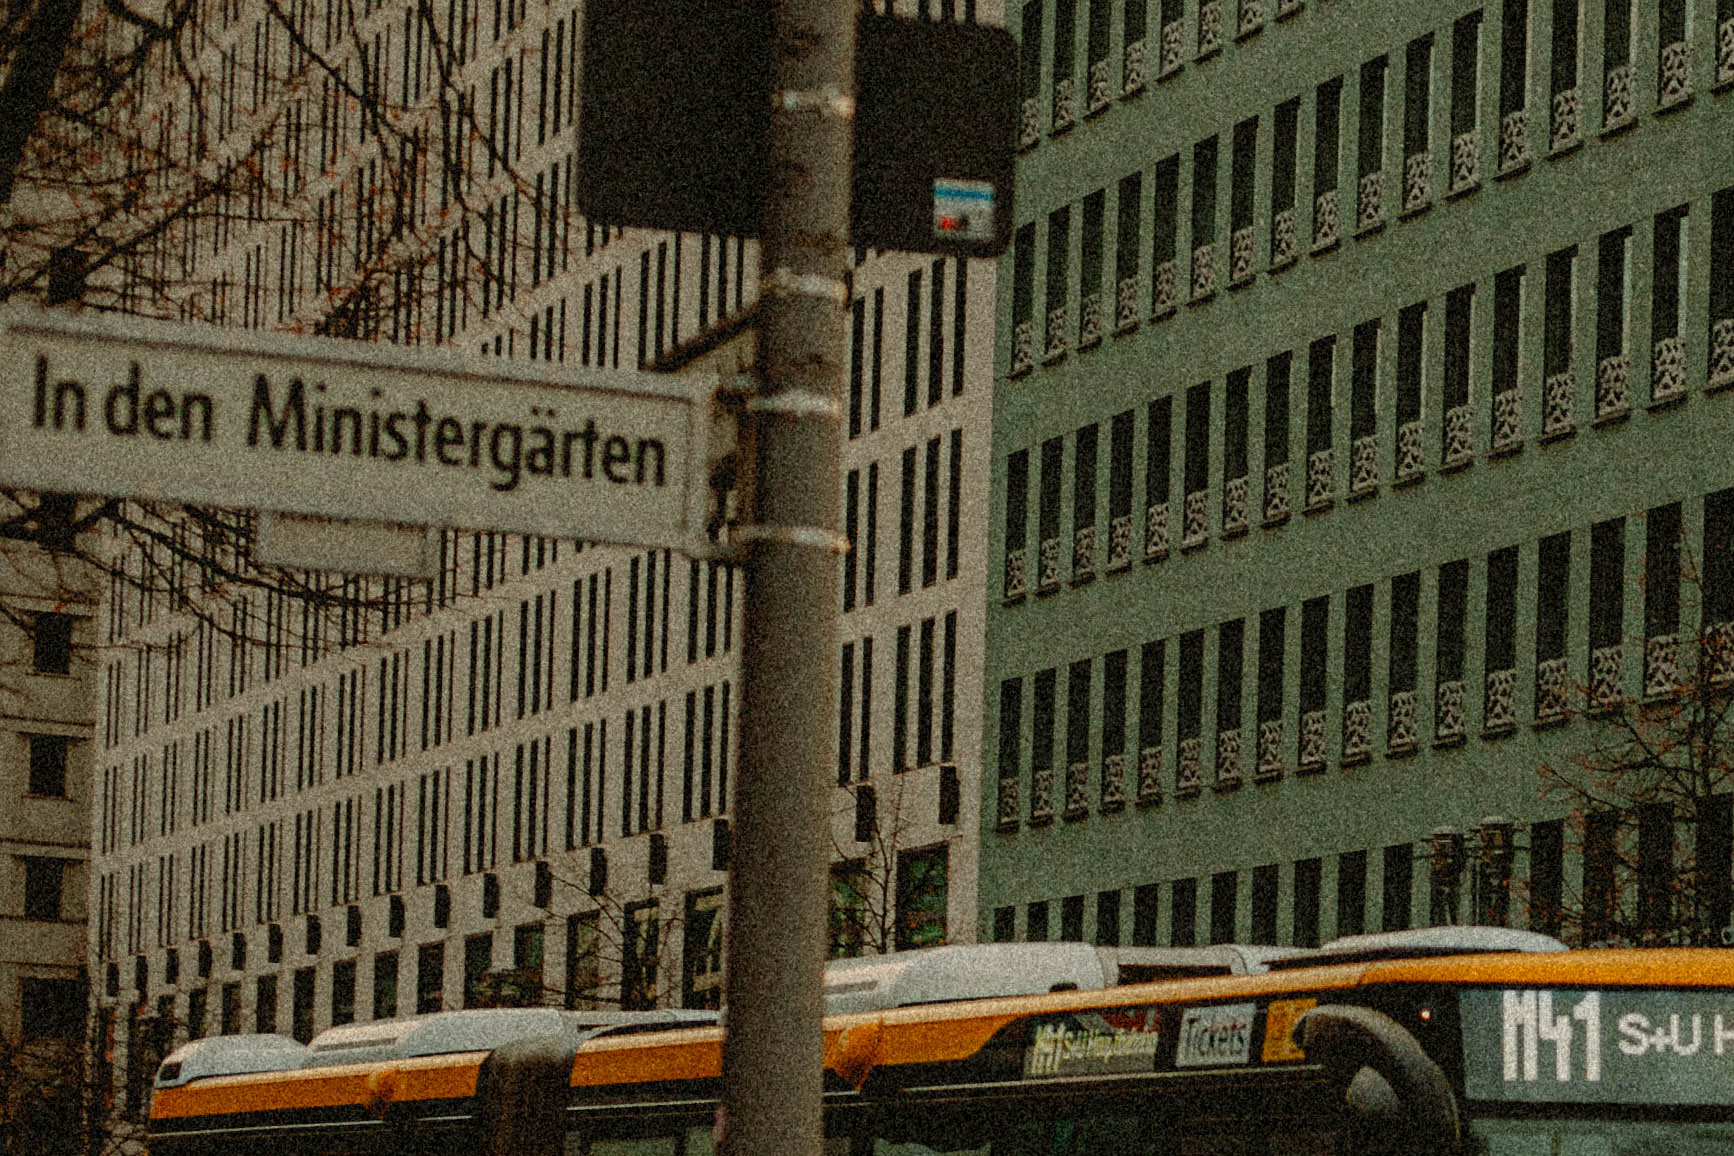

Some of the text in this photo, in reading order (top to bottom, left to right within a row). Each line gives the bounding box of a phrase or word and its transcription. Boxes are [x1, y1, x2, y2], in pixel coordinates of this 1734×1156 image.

[33, 356, 667, 492] In den Ministergärten
[1185, 1017, 1248, 1057] Tickets
[1502, 989, 1602, 1082] M41
[1617, 1012, 1702, 1057] S+U
